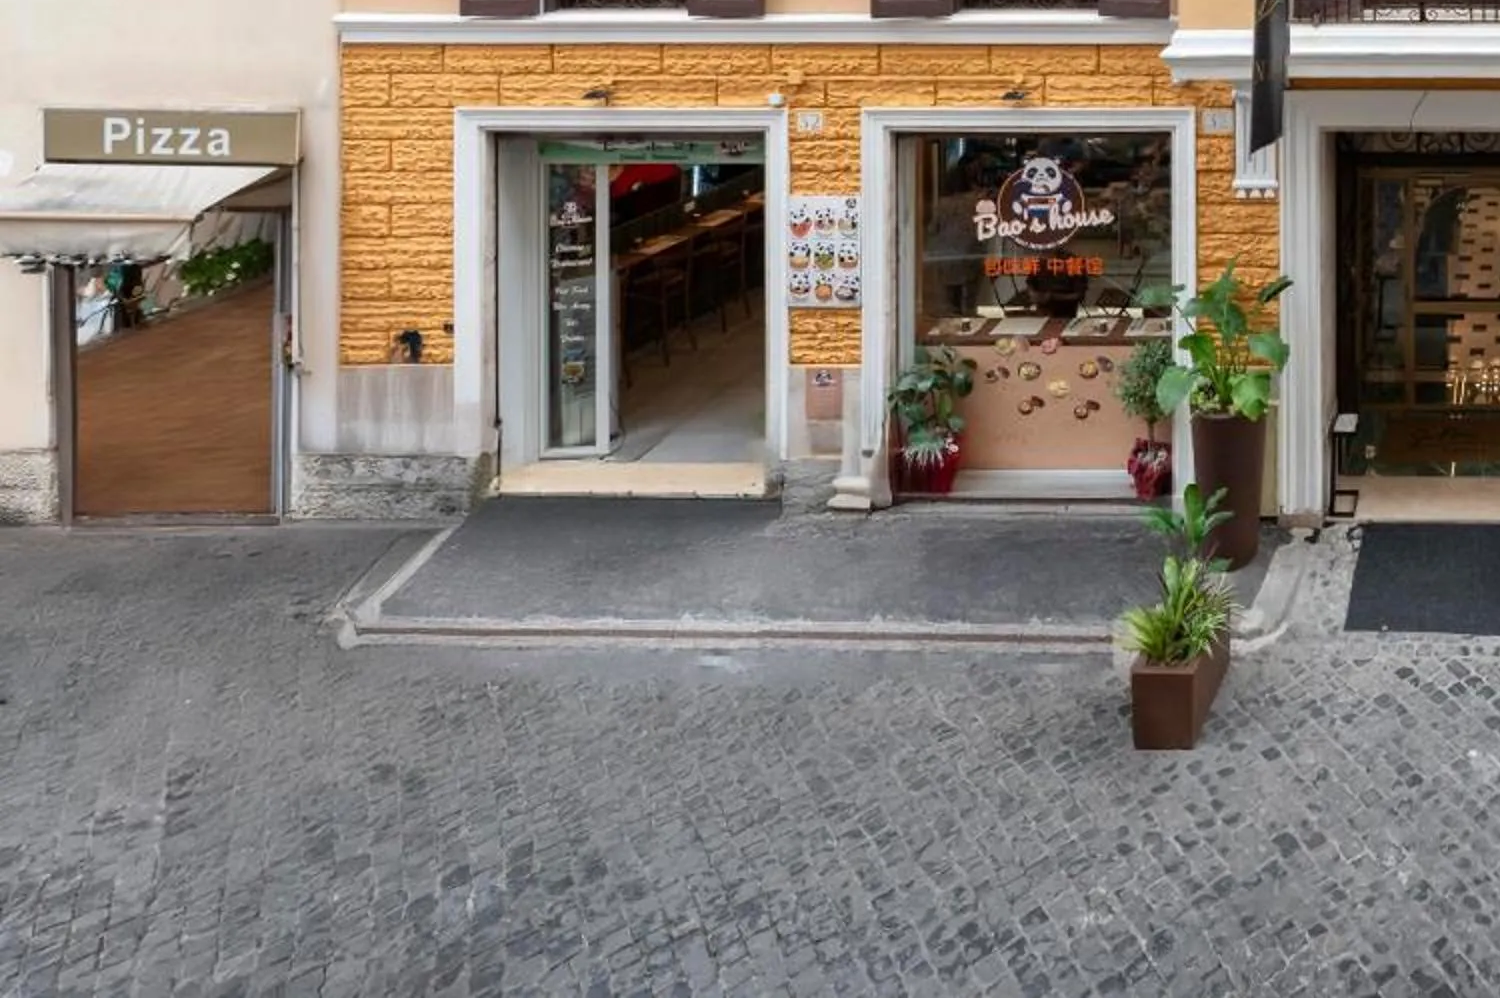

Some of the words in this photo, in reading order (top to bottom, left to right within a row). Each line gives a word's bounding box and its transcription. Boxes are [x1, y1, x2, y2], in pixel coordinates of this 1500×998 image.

[102, 117, 232, 156] Pizza
[972, 211, 1047, 242] Bao's
[1048, 202, 1115, 231] house
